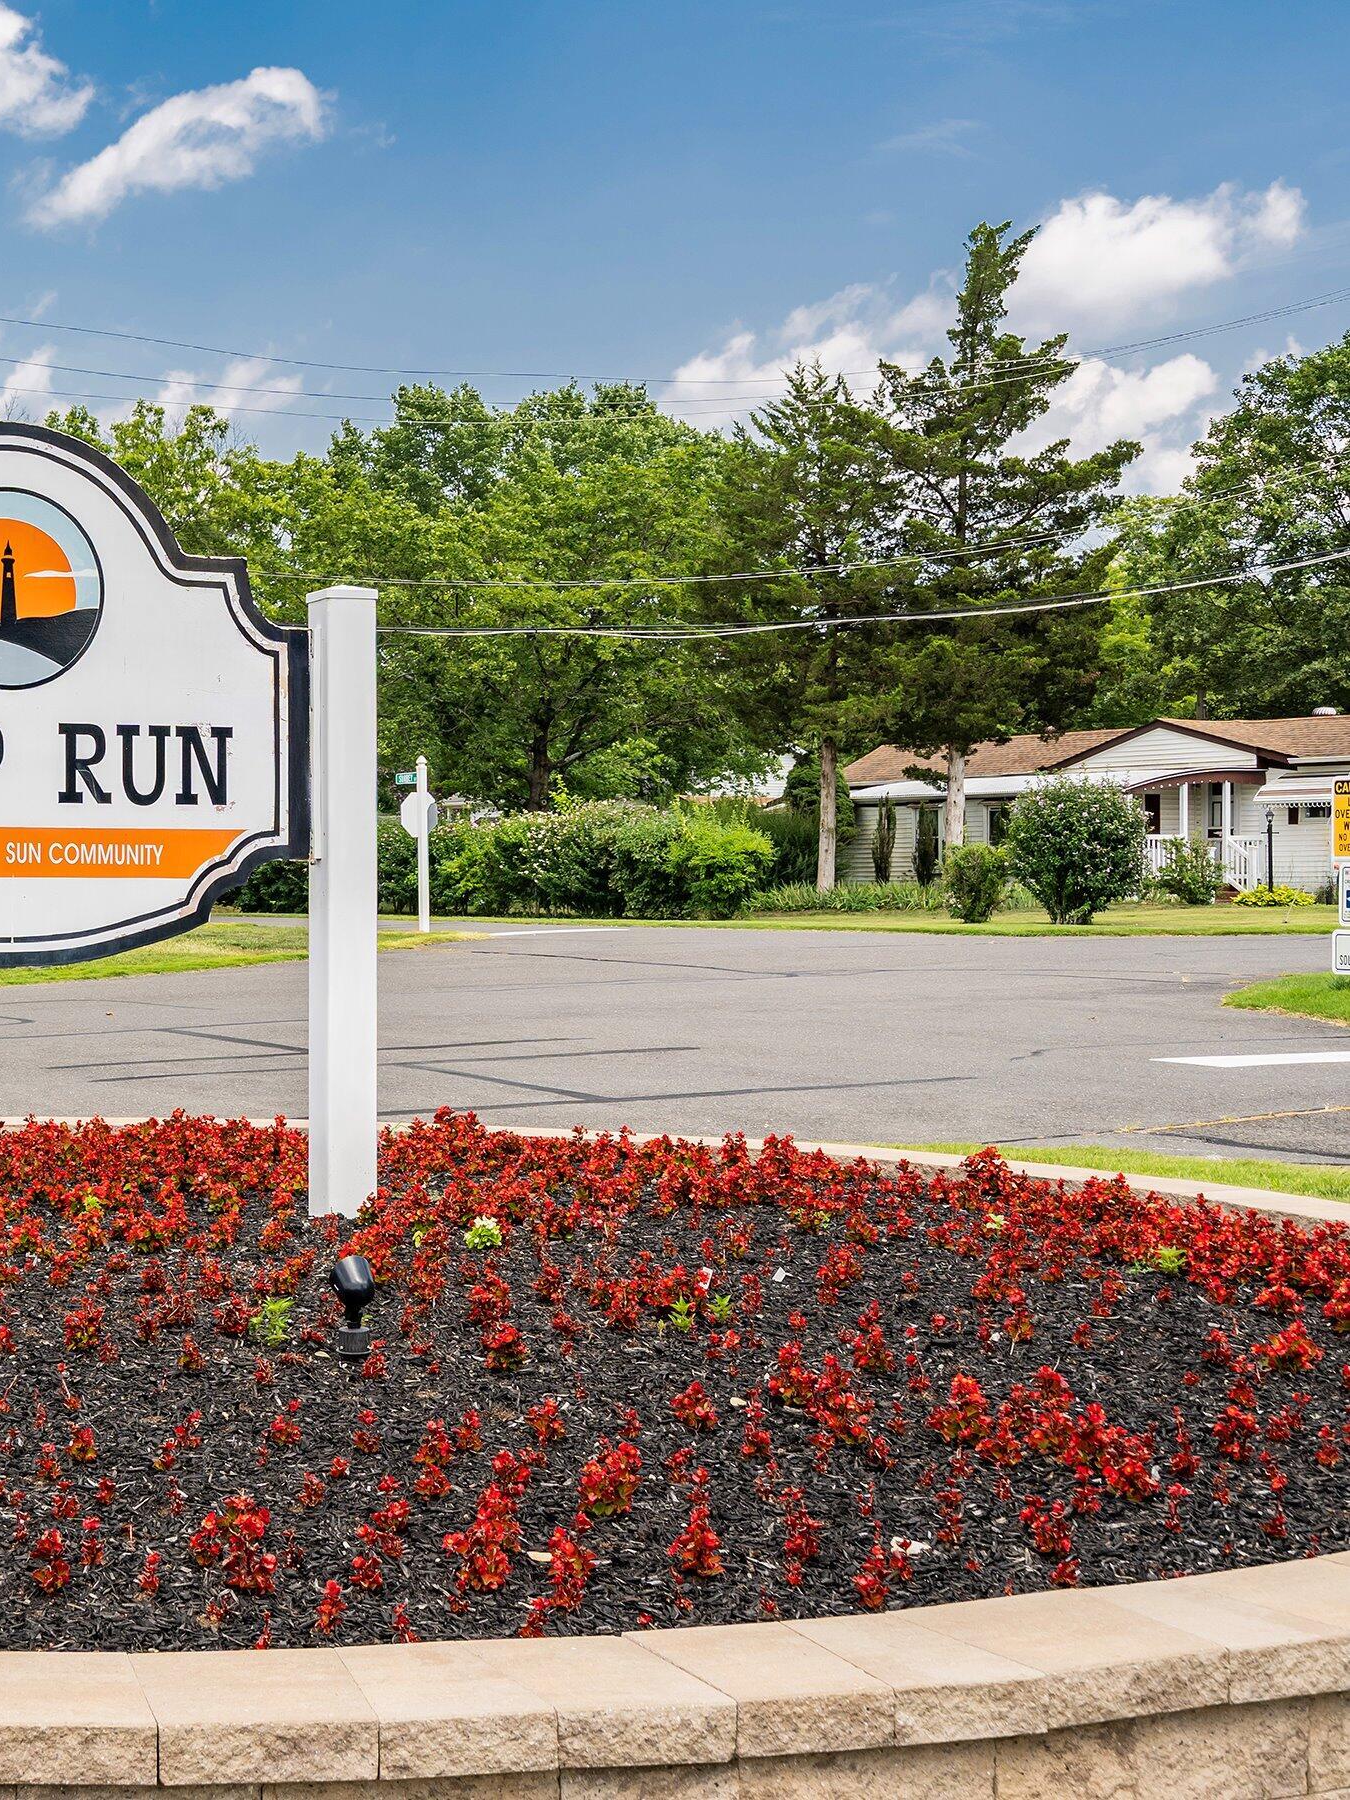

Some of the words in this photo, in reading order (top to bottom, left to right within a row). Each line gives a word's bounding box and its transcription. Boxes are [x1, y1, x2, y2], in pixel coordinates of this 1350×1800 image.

[58, 723, 233, 805] RUN
[1339, 833, 1347, 842] NO
[5, 842, 41, 864] SUN
[48, 842, 163, 865] COMMUNITY
